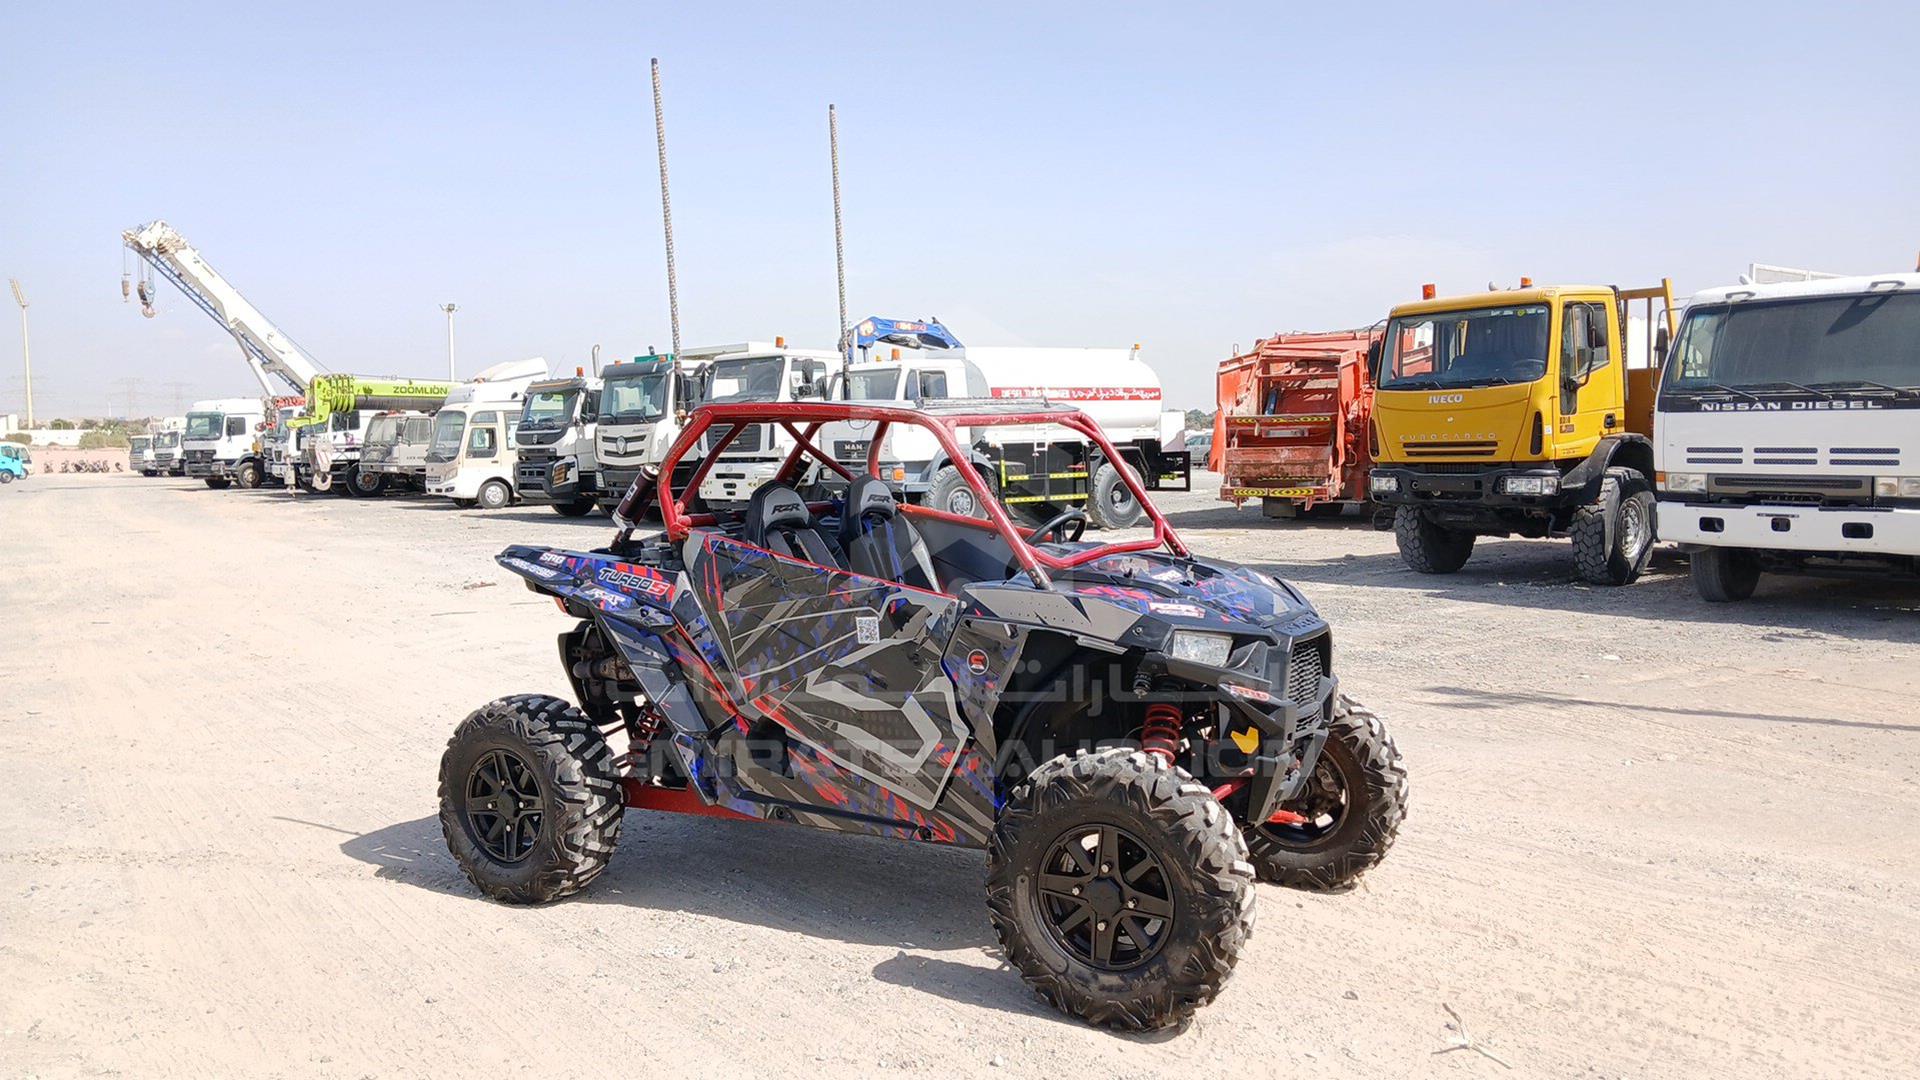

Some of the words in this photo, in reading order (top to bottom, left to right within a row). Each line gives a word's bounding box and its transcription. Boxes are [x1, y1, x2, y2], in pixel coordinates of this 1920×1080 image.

[392, 385, 448, 395] ZOOMLION
[1428, 394, 1464, 405] IVECO
[1701, 401, 1781, 411] NISSAN
[1791, 400, 1882, 410] DIESEL
[844, 443, 863, 451] MAN
[867, 493, 891, 504] RZR
[770, 502, 801, 516] RZR
